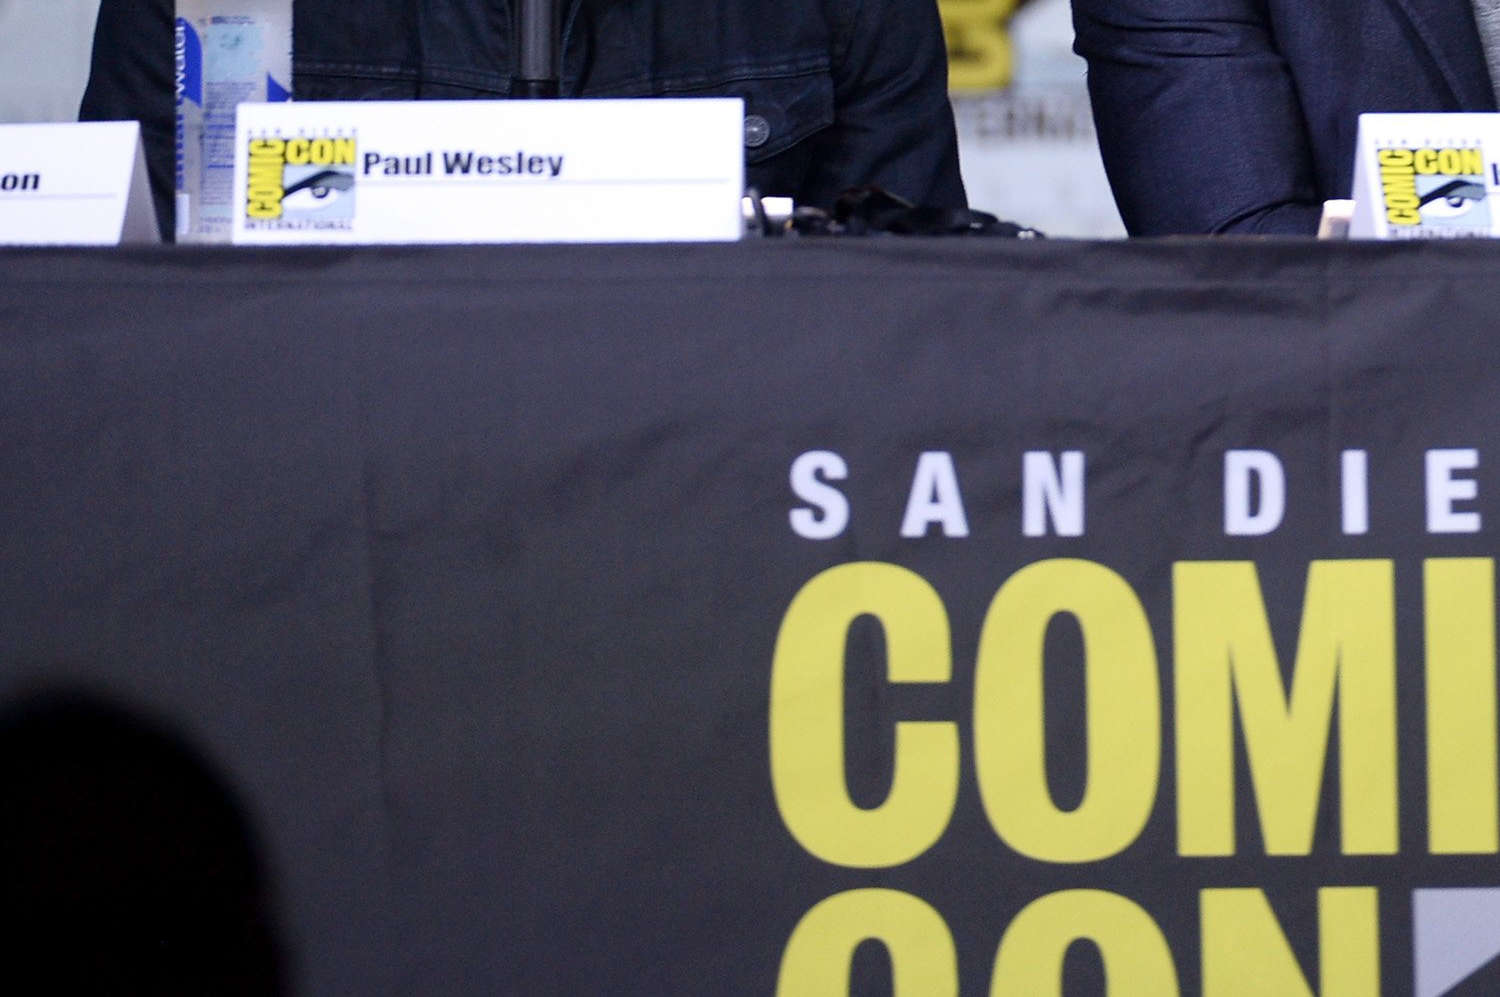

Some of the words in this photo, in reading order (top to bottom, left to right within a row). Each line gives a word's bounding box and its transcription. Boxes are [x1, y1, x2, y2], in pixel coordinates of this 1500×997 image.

[286, 139, 356, 165] CON
[363, 152, 432, 175] Paul
[443, 151, 563, 177] Wesley
[1413, 148, 1484, 176] CON
[247, 139, 286, 219] COMIC
[1379, 149, 1421, 226] COMIC
[789, 449, 1085, 540] SAN
